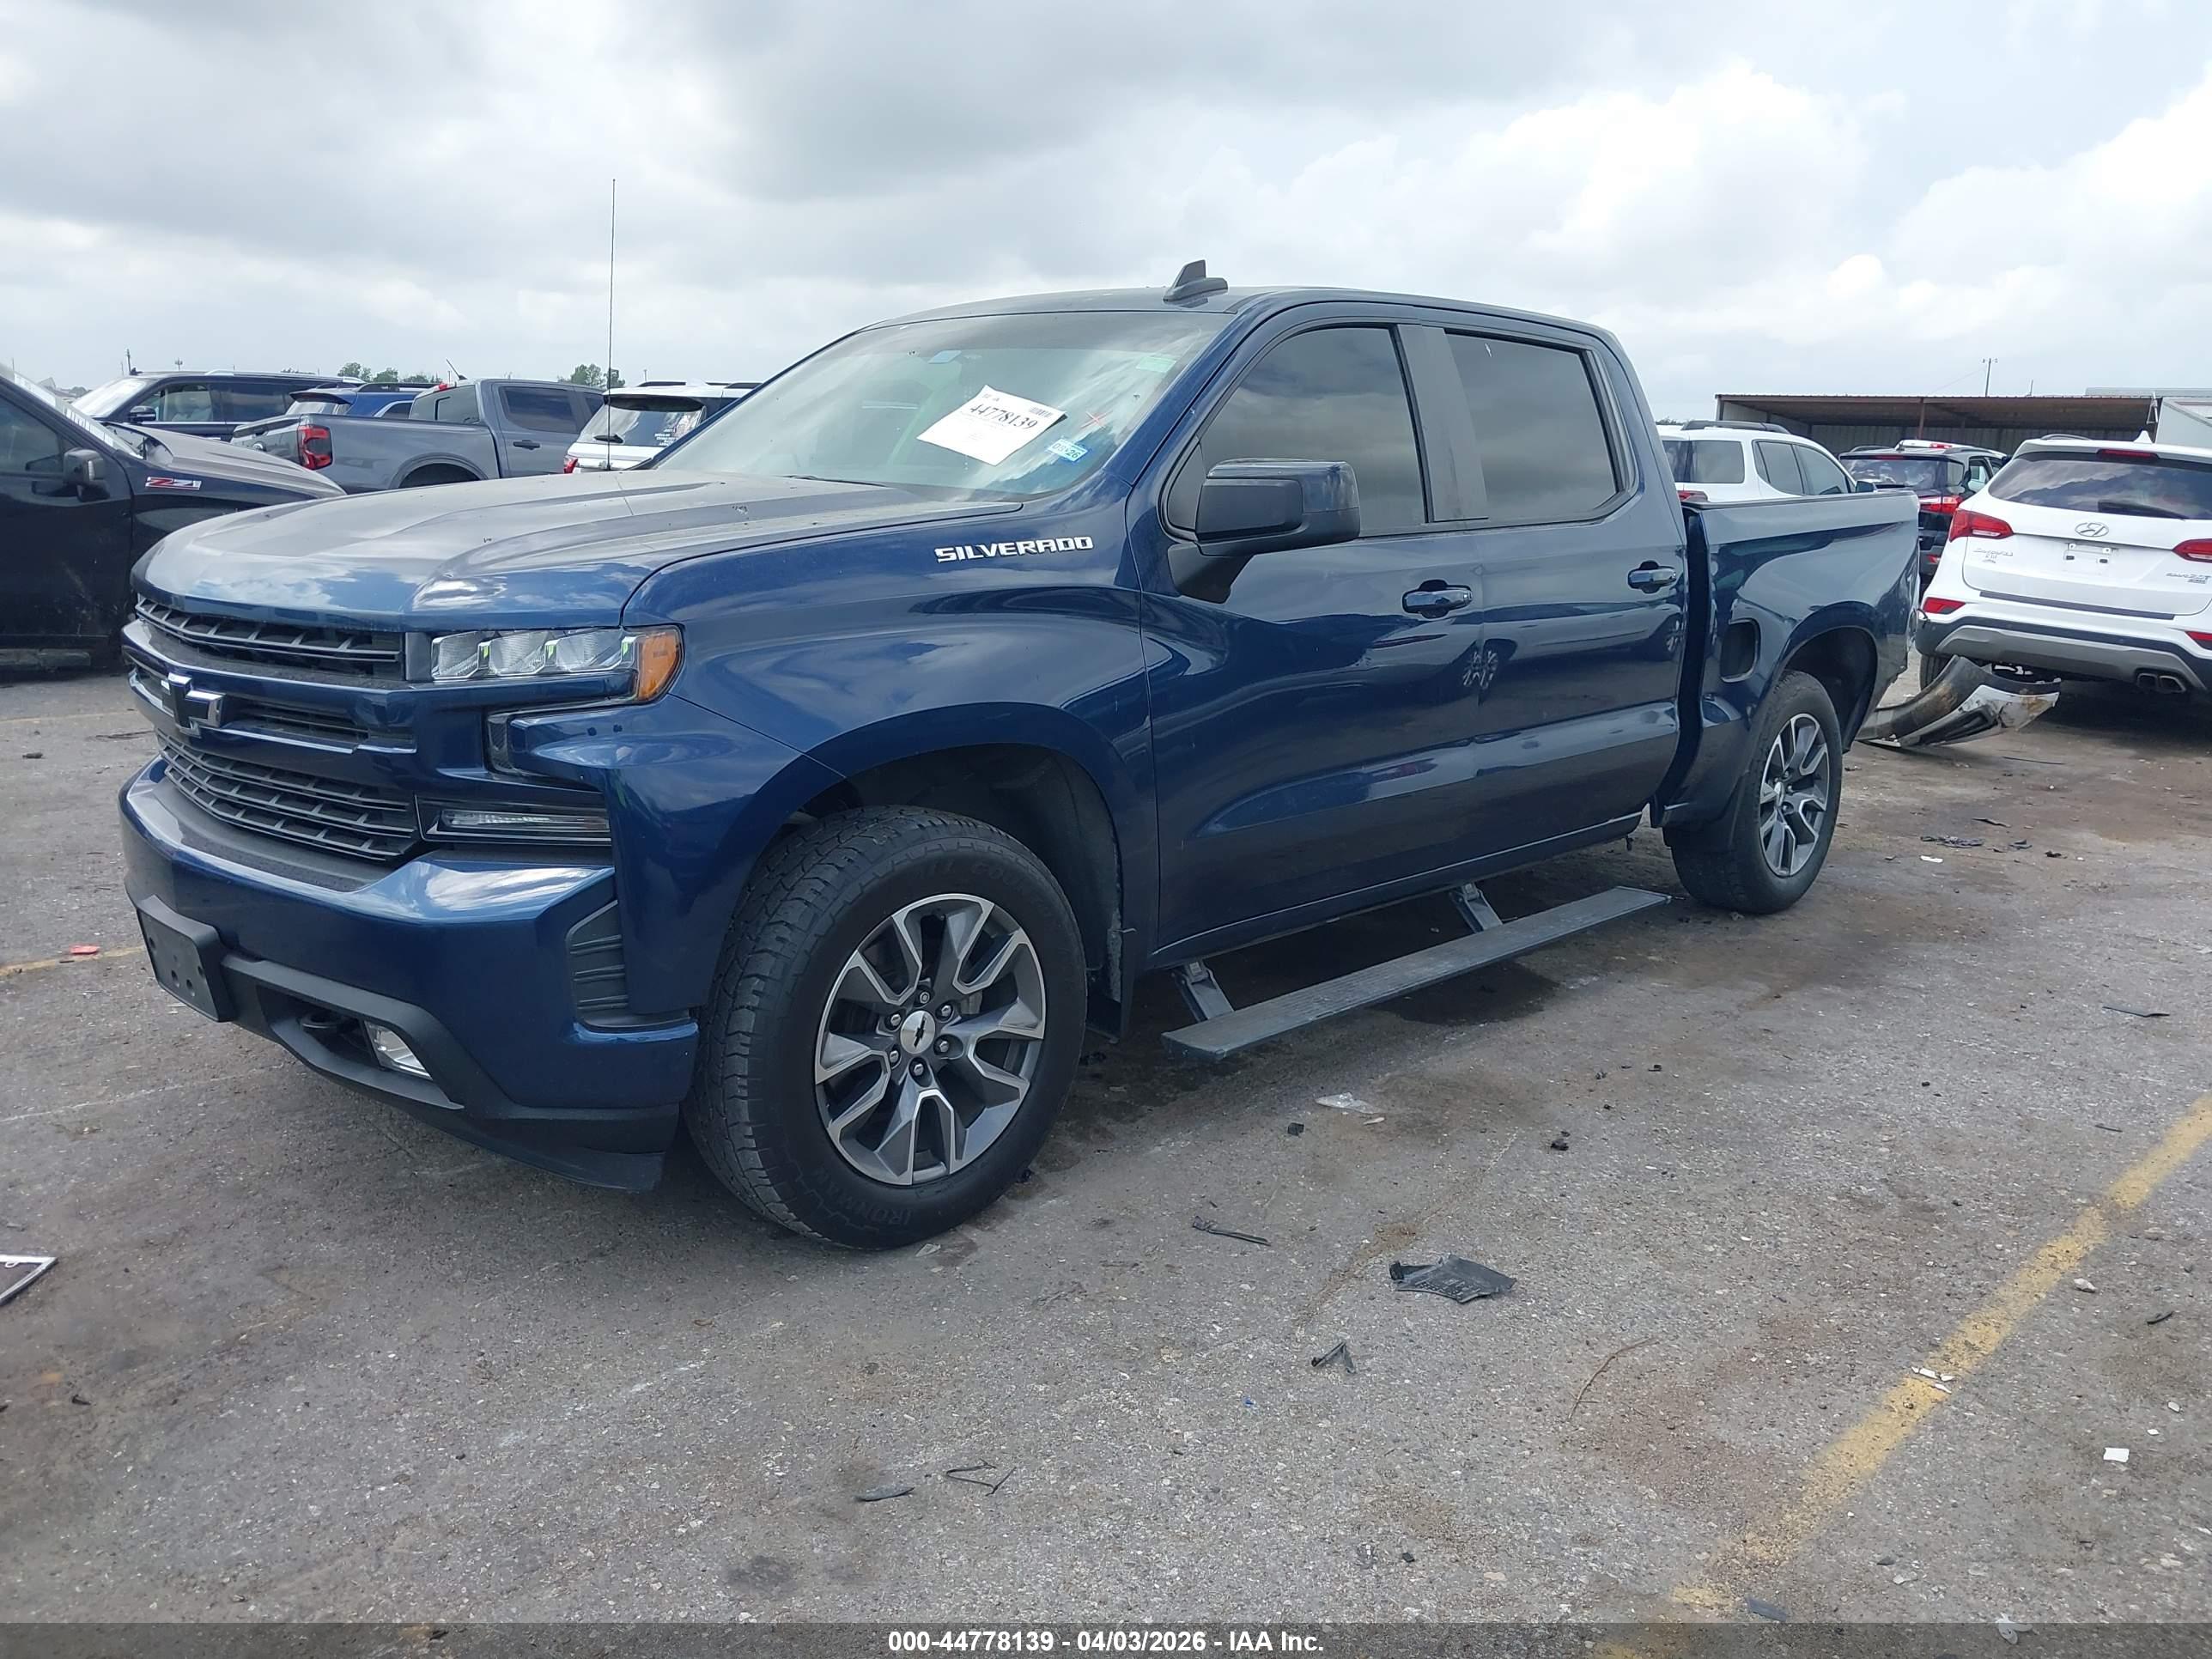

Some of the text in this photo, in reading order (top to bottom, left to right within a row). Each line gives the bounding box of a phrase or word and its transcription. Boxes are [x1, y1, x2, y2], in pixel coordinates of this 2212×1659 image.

[969, 404, 1038, 430] 44778139
[1065, 449, 1081, 459] 26
[934, 536, 1094, 563] SILVERADO
